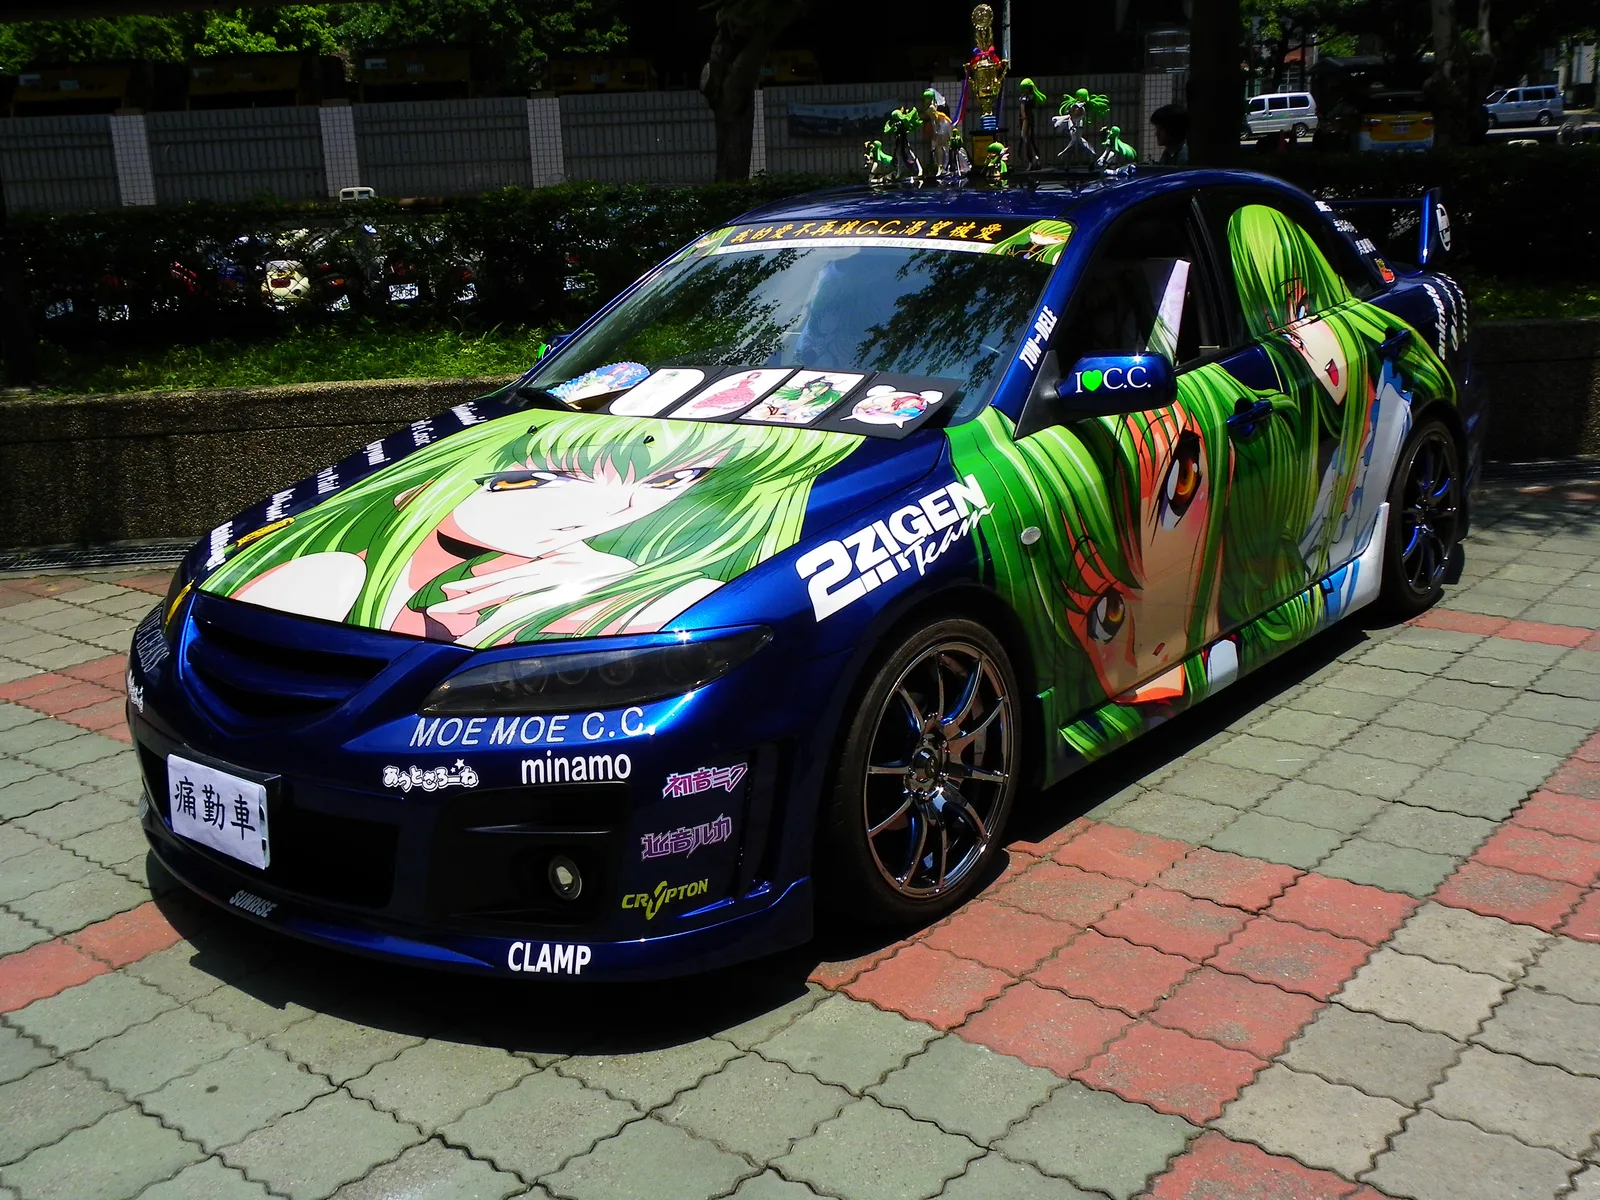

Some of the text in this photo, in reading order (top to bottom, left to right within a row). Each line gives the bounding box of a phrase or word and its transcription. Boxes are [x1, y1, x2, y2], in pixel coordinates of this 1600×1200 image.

[1075, 366, 1152, 393] I C.C.
[795, 473, 988, 623] 2ZIGEN
[904, 502, 995, 577] Team
[409, 706, 656, 747] MOE MOE C.C.
[521, 750, 632, 785] minamo
[662, 762, 748, 798] 初音ミク
[174, 775, 256, 841] 痛勤車
[641, 813, 732, 860] 巡音ルカ
[229, 889, 278, 918] SUNRISE
[621, 878, 709, 921] CRYPTON
[507, 941, 592, 975] CLAMP
